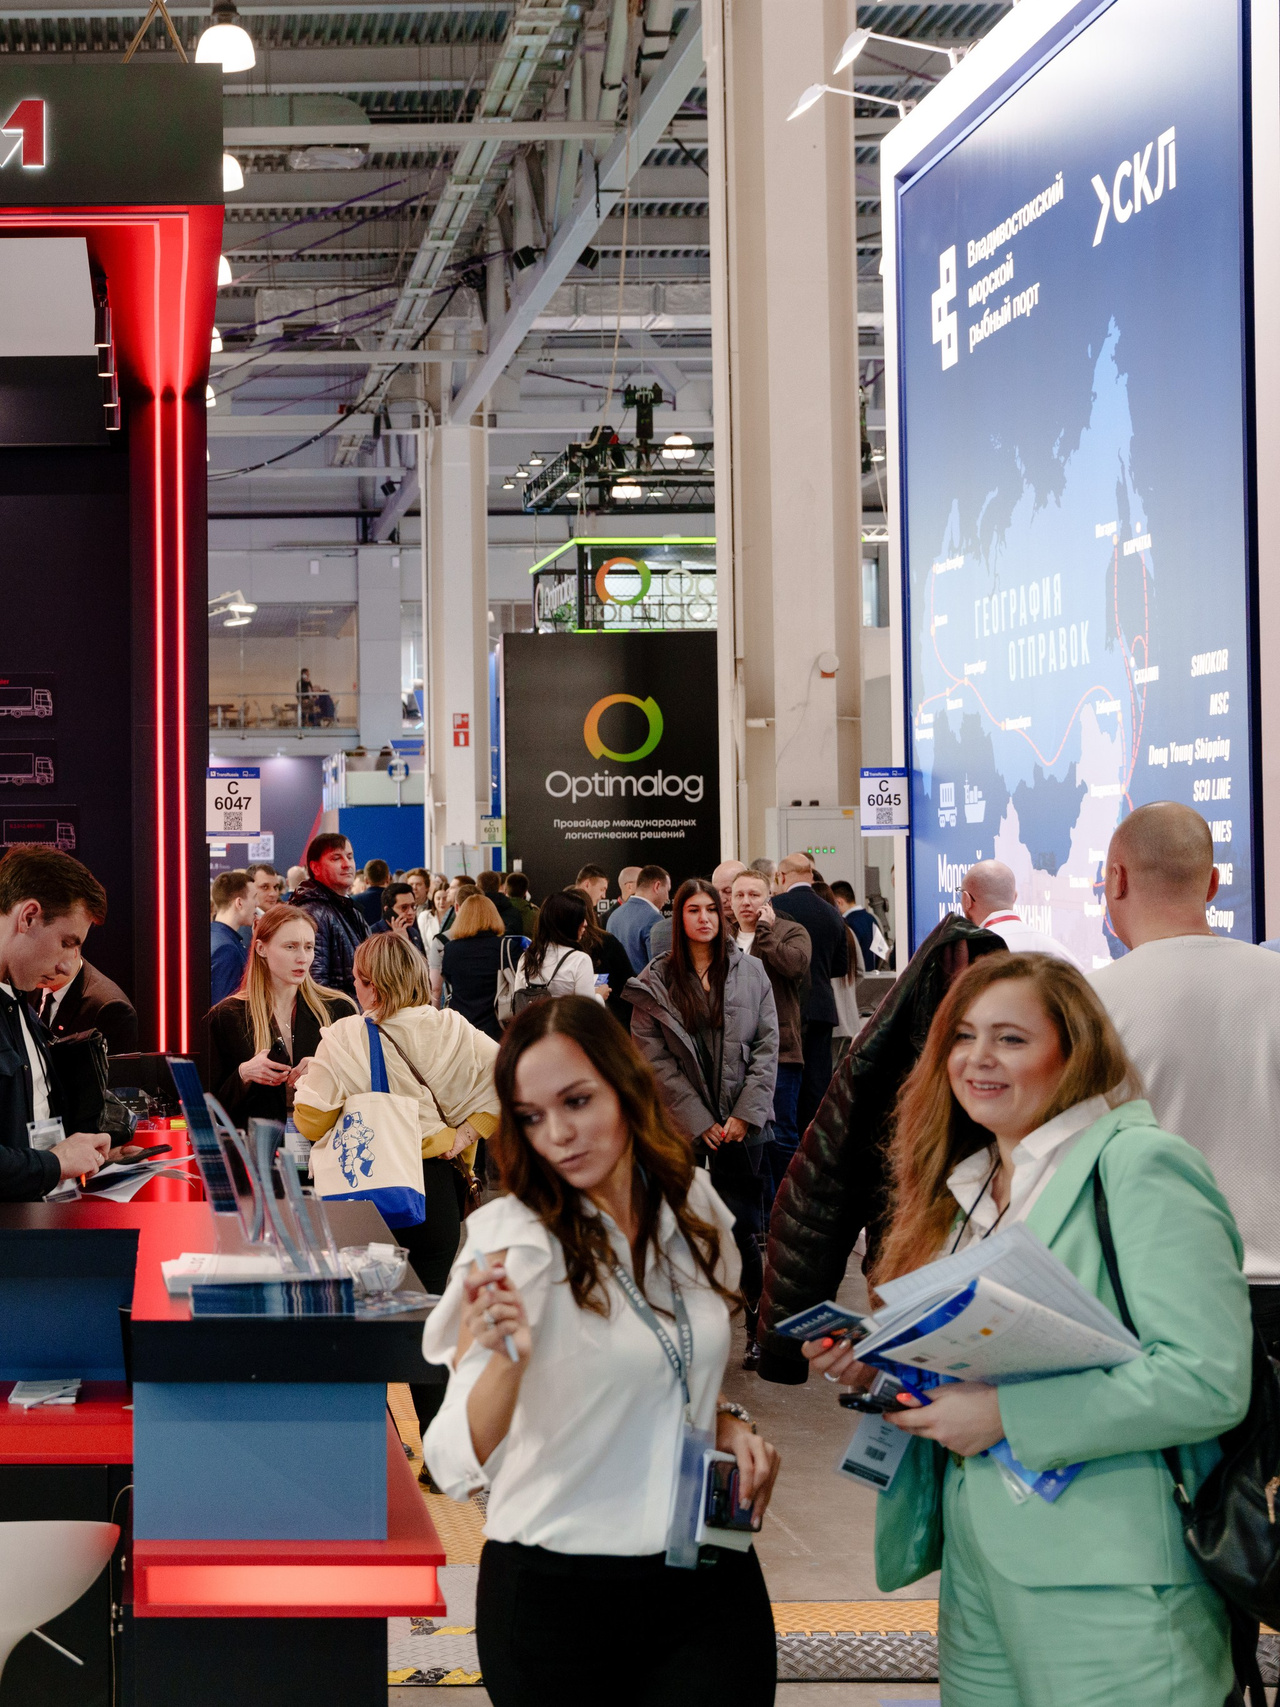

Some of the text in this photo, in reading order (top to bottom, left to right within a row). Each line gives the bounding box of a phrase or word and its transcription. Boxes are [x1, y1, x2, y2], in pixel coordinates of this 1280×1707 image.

[967, 170, 1064, 268] Владивостокский
[968, 251, 1014, 308] морской
[969, 282, 1040, 354] рыбный порт
[974, 572, 1062, 640] ГЕОГРАФИЯ
[1008, 619, 1091, 682] ОТПРАВОК
[1209, 691, 1230, 716] MSC
[1170, 742, 1193, 766] Young
[1194, 736, 1231, 763] Shipping
[227, 781, 239, 795] C
[545, 769, 704, 804] Optimalog
[878, 780, 889, 792] C
[1193, 777, 1232, 802] SCO LINE
[214, 797, 252, 810] 6047
[867, 794, 901, 806] 6045
[553, 819, 697, 829] Провайдер международных
[565, 829, 685, 840] логистических решений
[938, 850, 982, 904] Морс
